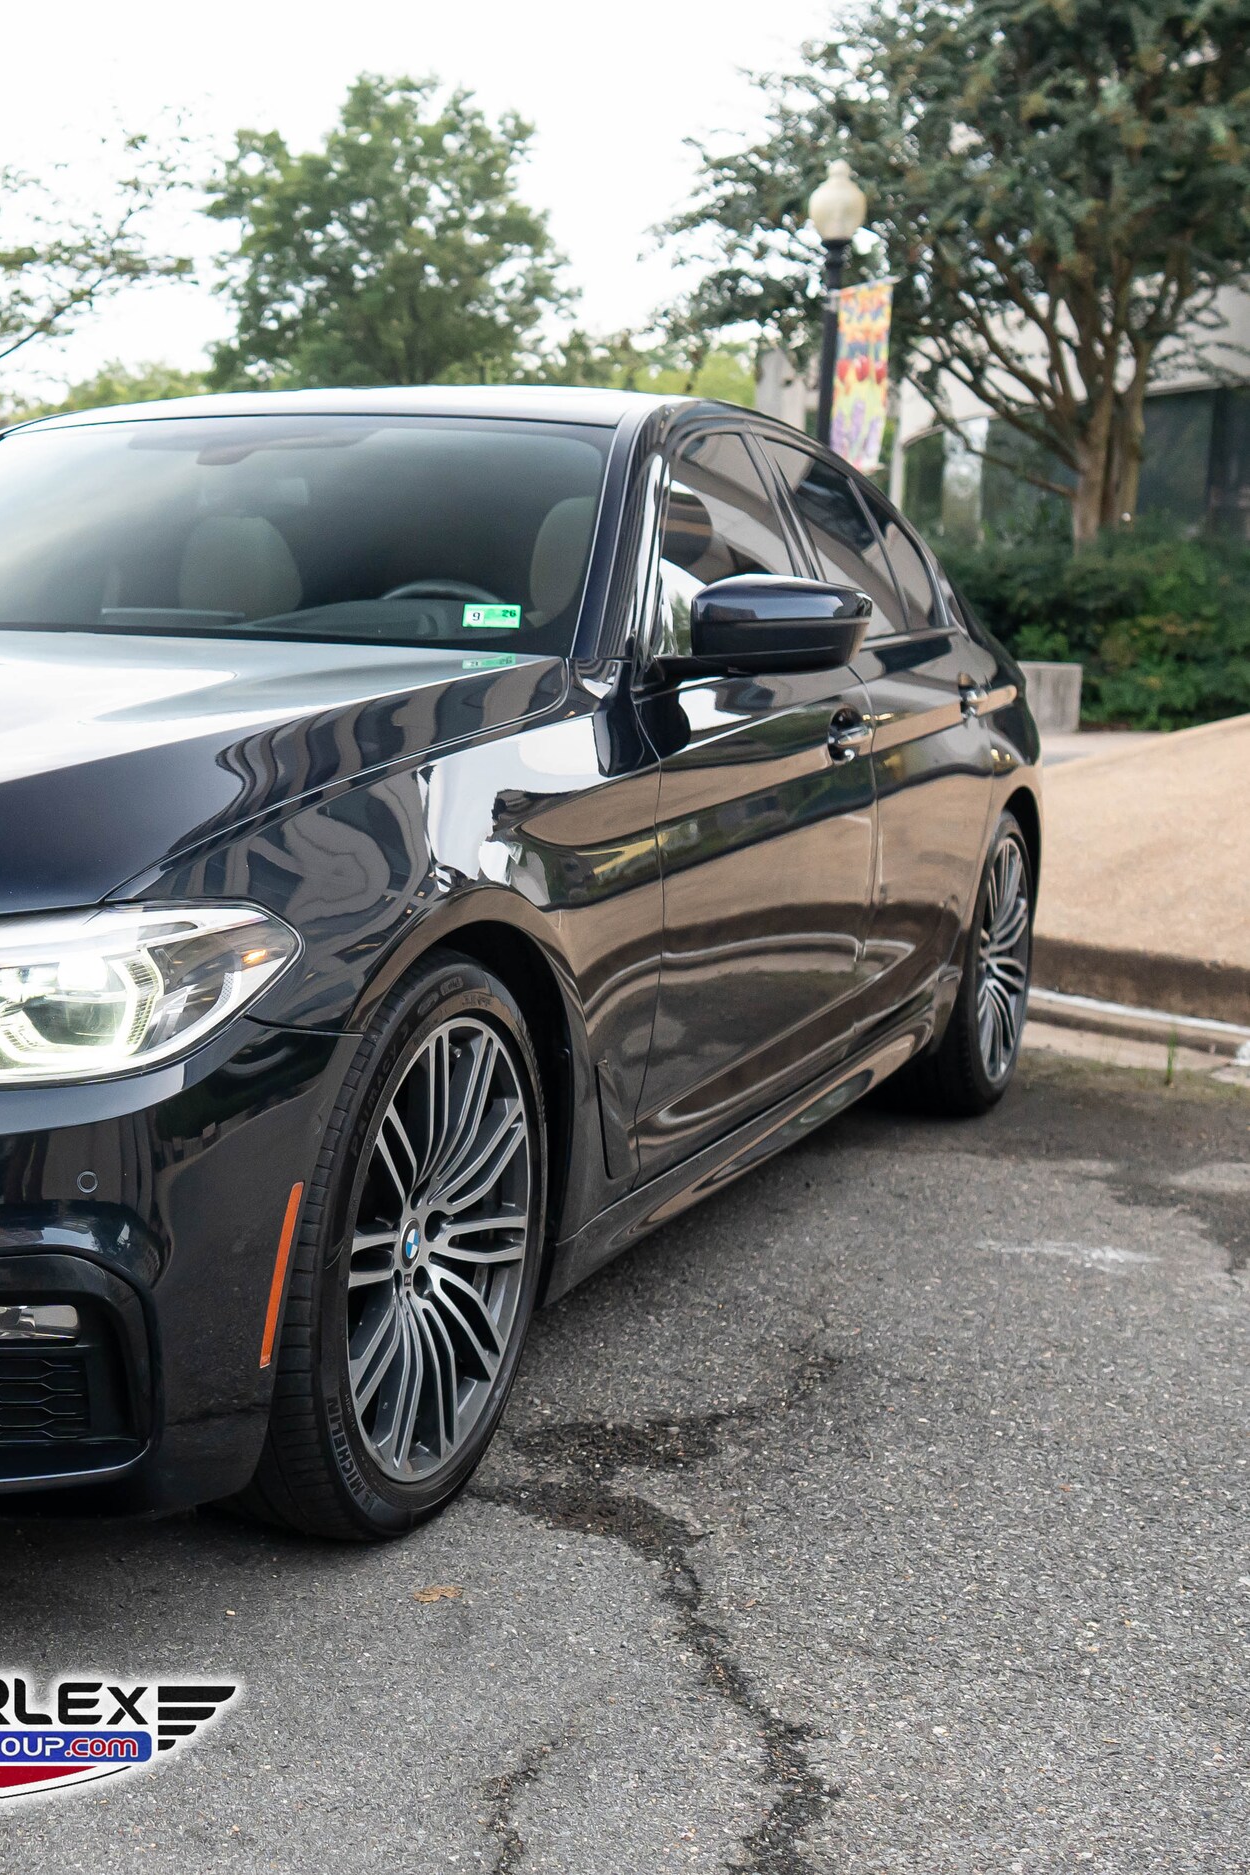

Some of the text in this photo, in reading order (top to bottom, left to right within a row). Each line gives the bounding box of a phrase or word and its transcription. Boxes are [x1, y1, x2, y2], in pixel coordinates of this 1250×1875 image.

[472, 611, 481, 621] 9
[501, 609, 517, 618] 26
[327, 1396, 369, 1497] MICHELIN
